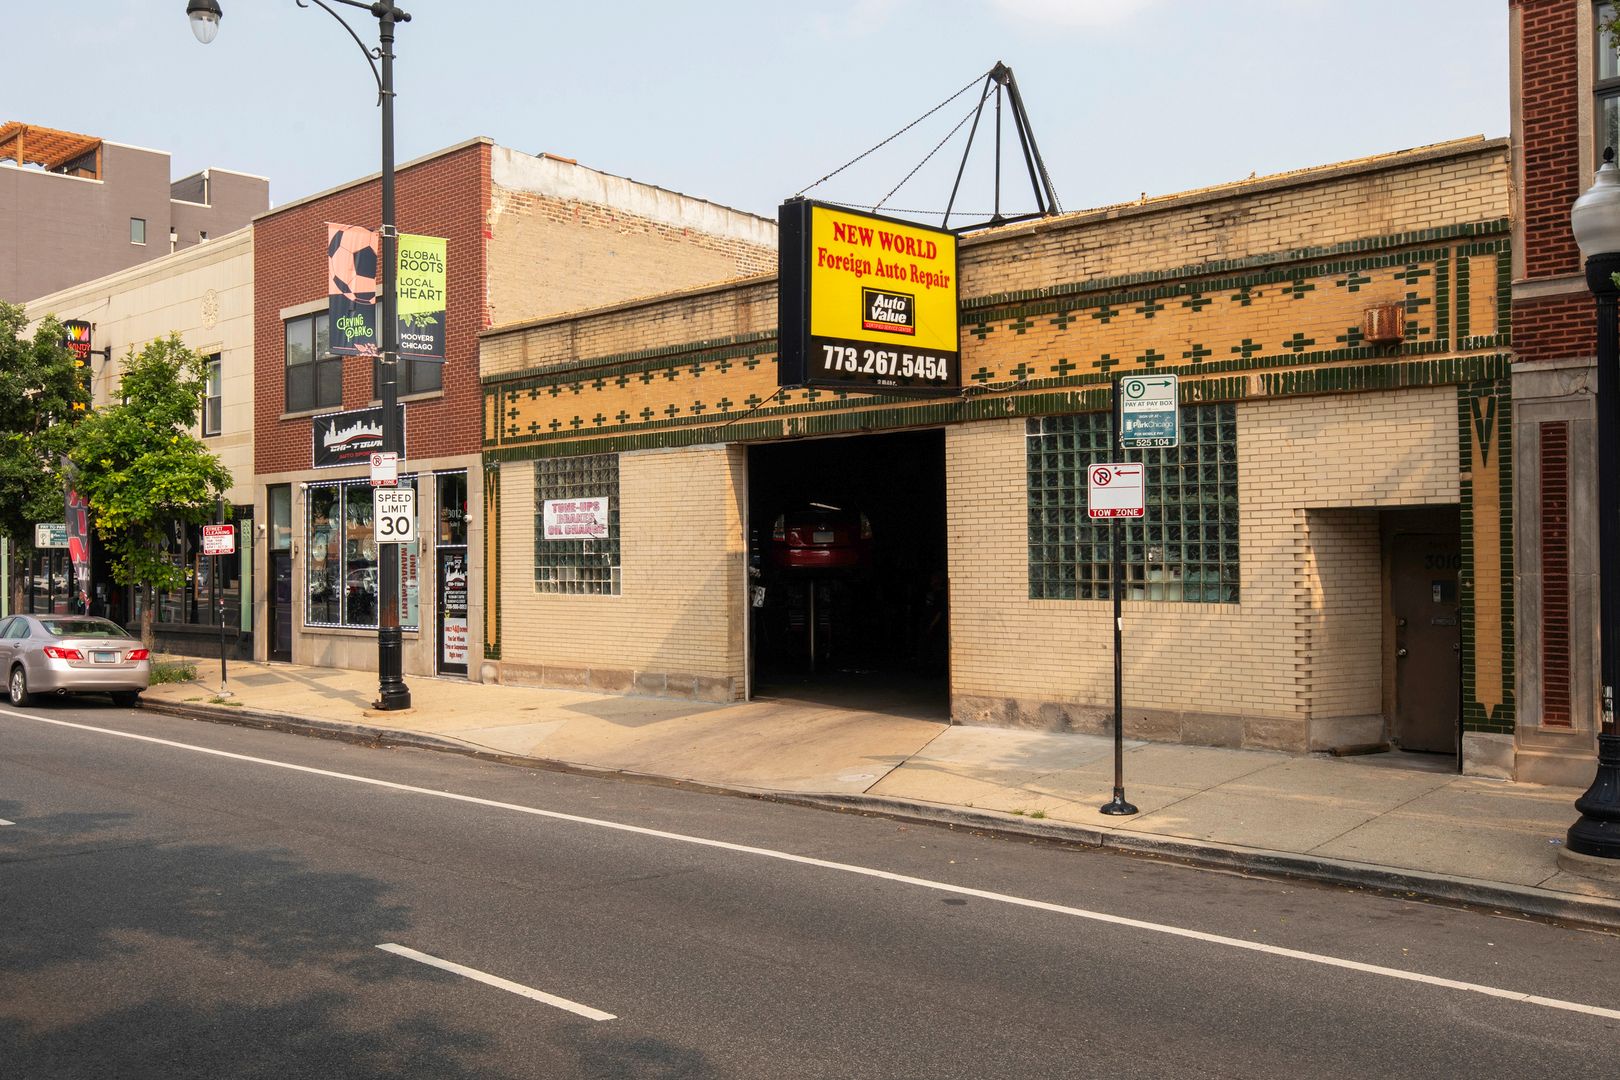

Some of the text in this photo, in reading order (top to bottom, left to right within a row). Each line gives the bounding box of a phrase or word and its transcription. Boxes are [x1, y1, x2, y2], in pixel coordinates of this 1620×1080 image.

[833, 221, 937, 260] NEW WORLD
[400, 250, 441, 262] GLOBAL
[400, 259, 443, 274] ROOTS
[817, 247, 950, 290] Foreign Auto Repair
[400, 278, 434, 288] LOCAL
[400, 288, 442, 301] HEART
[873, 294, 906, 310] Auto
[871, 306, 907, 324] Value
[336, 314, 364, 331] IRVING
[345, 325, 373, 342] PARK
[400, 333, 434, 342] MOOVERS
[402, 342, 433, 350] CHICAGO
[822, 345, 948, 380] 773.267.5454
[378, 494, 411, 502] SPEED
[382, 505, 408, 513] LIMIT
[552, 501, 600, 513] TUNE-UPS
[1092, 508, 1139, 517] TOW ZONE
[448, 509, 462, 518] 3012
[380, 516, 410, 535] 30
[548, 525, 563, 535] OIL
